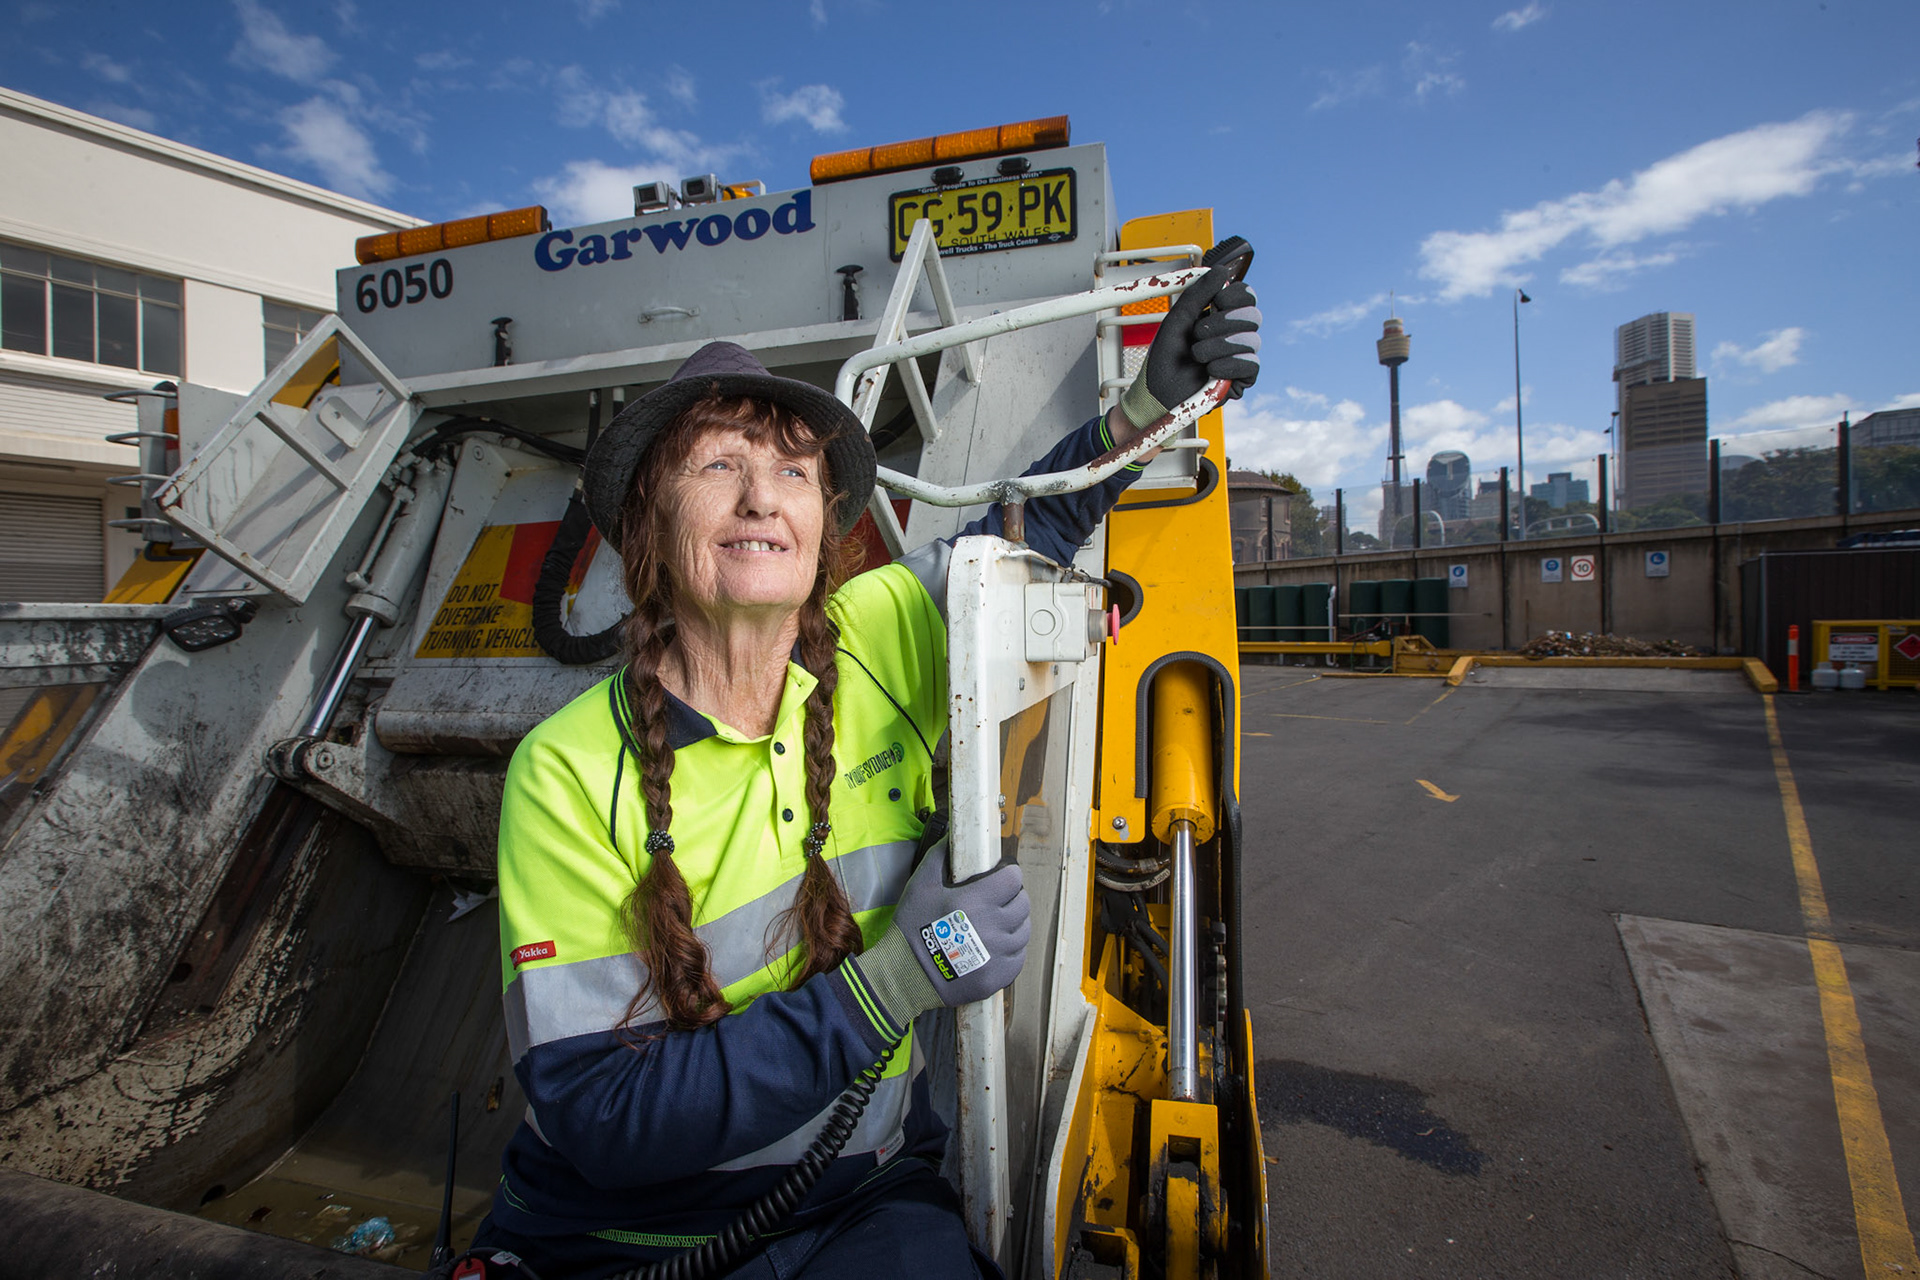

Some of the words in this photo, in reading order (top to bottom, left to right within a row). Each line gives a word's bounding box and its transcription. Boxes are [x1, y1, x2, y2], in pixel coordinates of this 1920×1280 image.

[942, 182, 966, 191] People
[988, 174, 1020, 183] Business
[535, 190, 816, 272] Garwood
[951, 233, 997, 247] SOUTH
[1005, 226, 1051, 240] WALES
[955, 244, 979, 253] Trucks
[983, 242, 997, 250] The
[998, 240, 1016, 248] Truck
[1016, 238, 1039, 246] Centre
[355, 258, 454, 314] 6050
[1576, 563, 1590, 573] 10
[448, 585, 468, 602] DO
[469, 583, 500, 601] NOT
[435, 605, 504, 626] OVERTAKE
[424, 630, 484, 648] TURNING
[519, 947, 548, 959] Yakka
